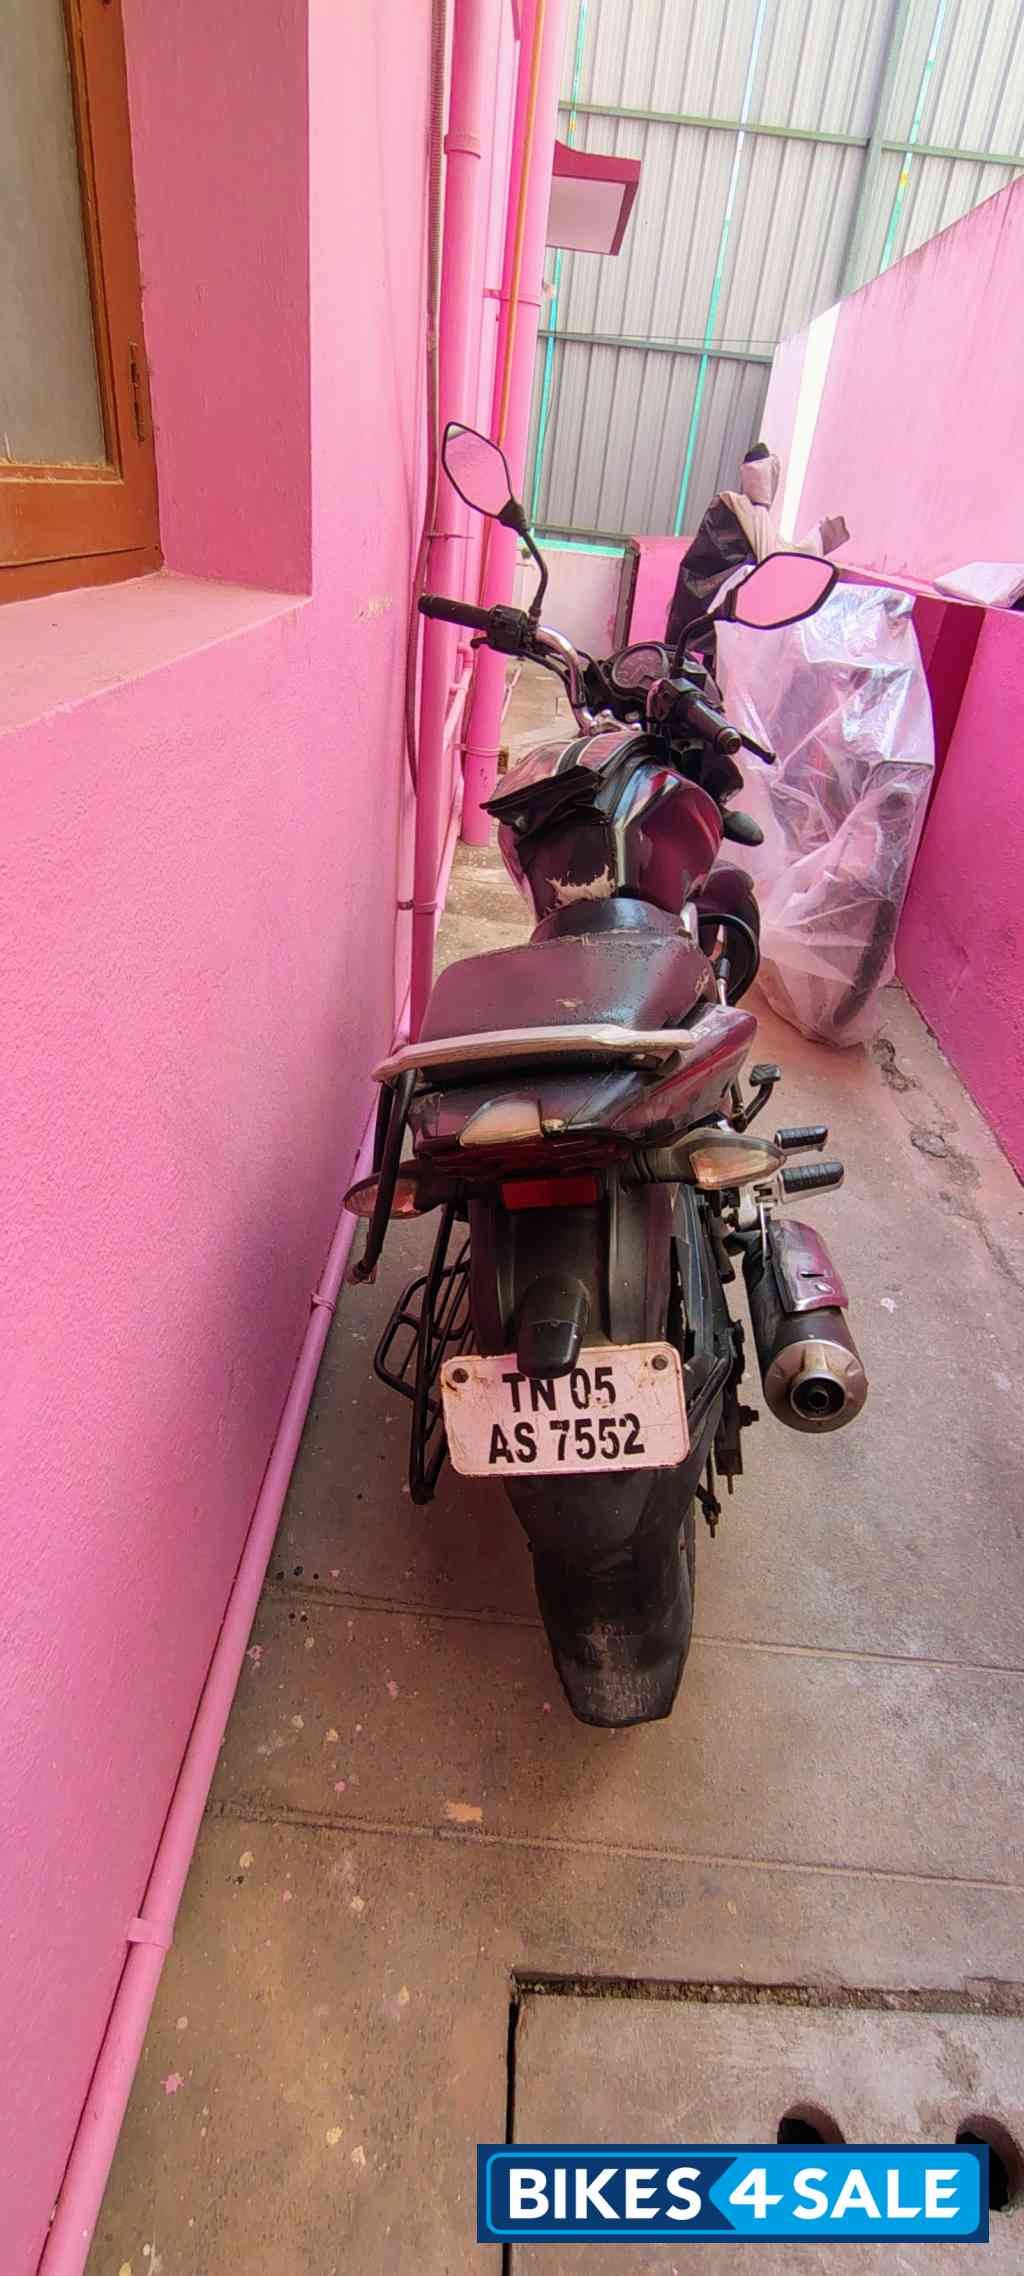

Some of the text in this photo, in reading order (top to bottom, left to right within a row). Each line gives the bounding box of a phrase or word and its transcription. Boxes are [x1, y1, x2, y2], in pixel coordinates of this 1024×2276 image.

[502, 1366, 617, 1413] TN 05
[488, 1412, 646, 1465] AS 7552
